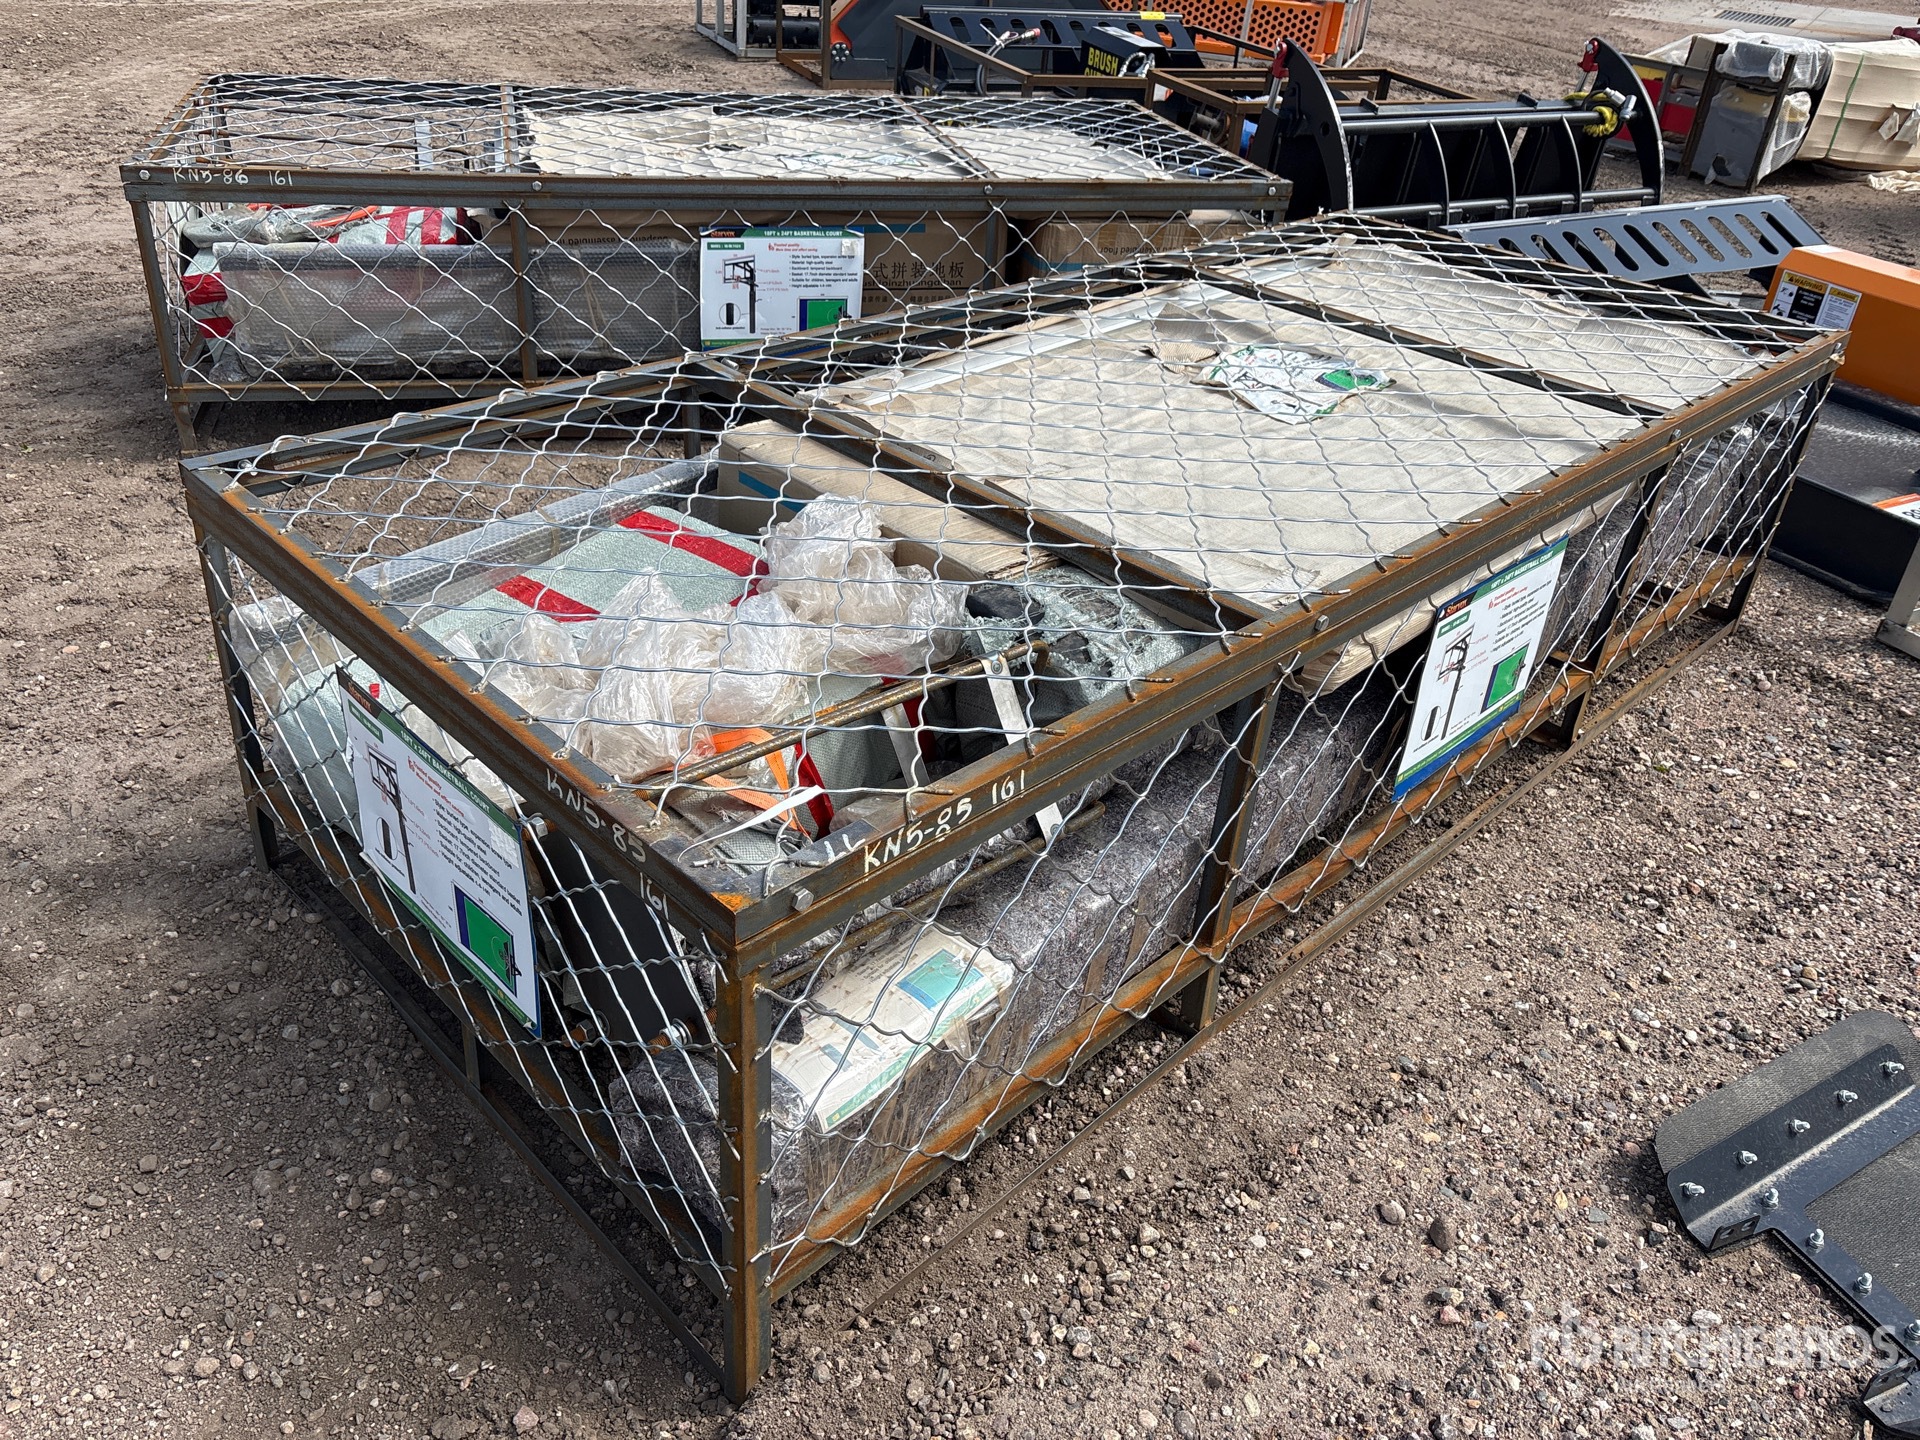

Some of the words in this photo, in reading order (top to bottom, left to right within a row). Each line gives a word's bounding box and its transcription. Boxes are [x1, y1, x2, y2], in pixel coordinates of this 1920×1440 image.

[1088, 47, 1119, 76] BRUSH
[269, 170, 293, 186] 161
[1794, 277, 1823, 291] WARNING
[1514, 559, 1540, 577] BASKETBALL
[1540, 551, 1554, 562] COURT
[1446, 599, 1469, 617] Starvox
[418, 746, 431, 761] 24FT
[432, 759, 469, 794] BASKETBALL
[470, 791, 490, 813] COURT
[864, 797, 972, 874] KN5-85
[992, 770, 1025, 805] 161
[640, 872, 669, 920] 161
